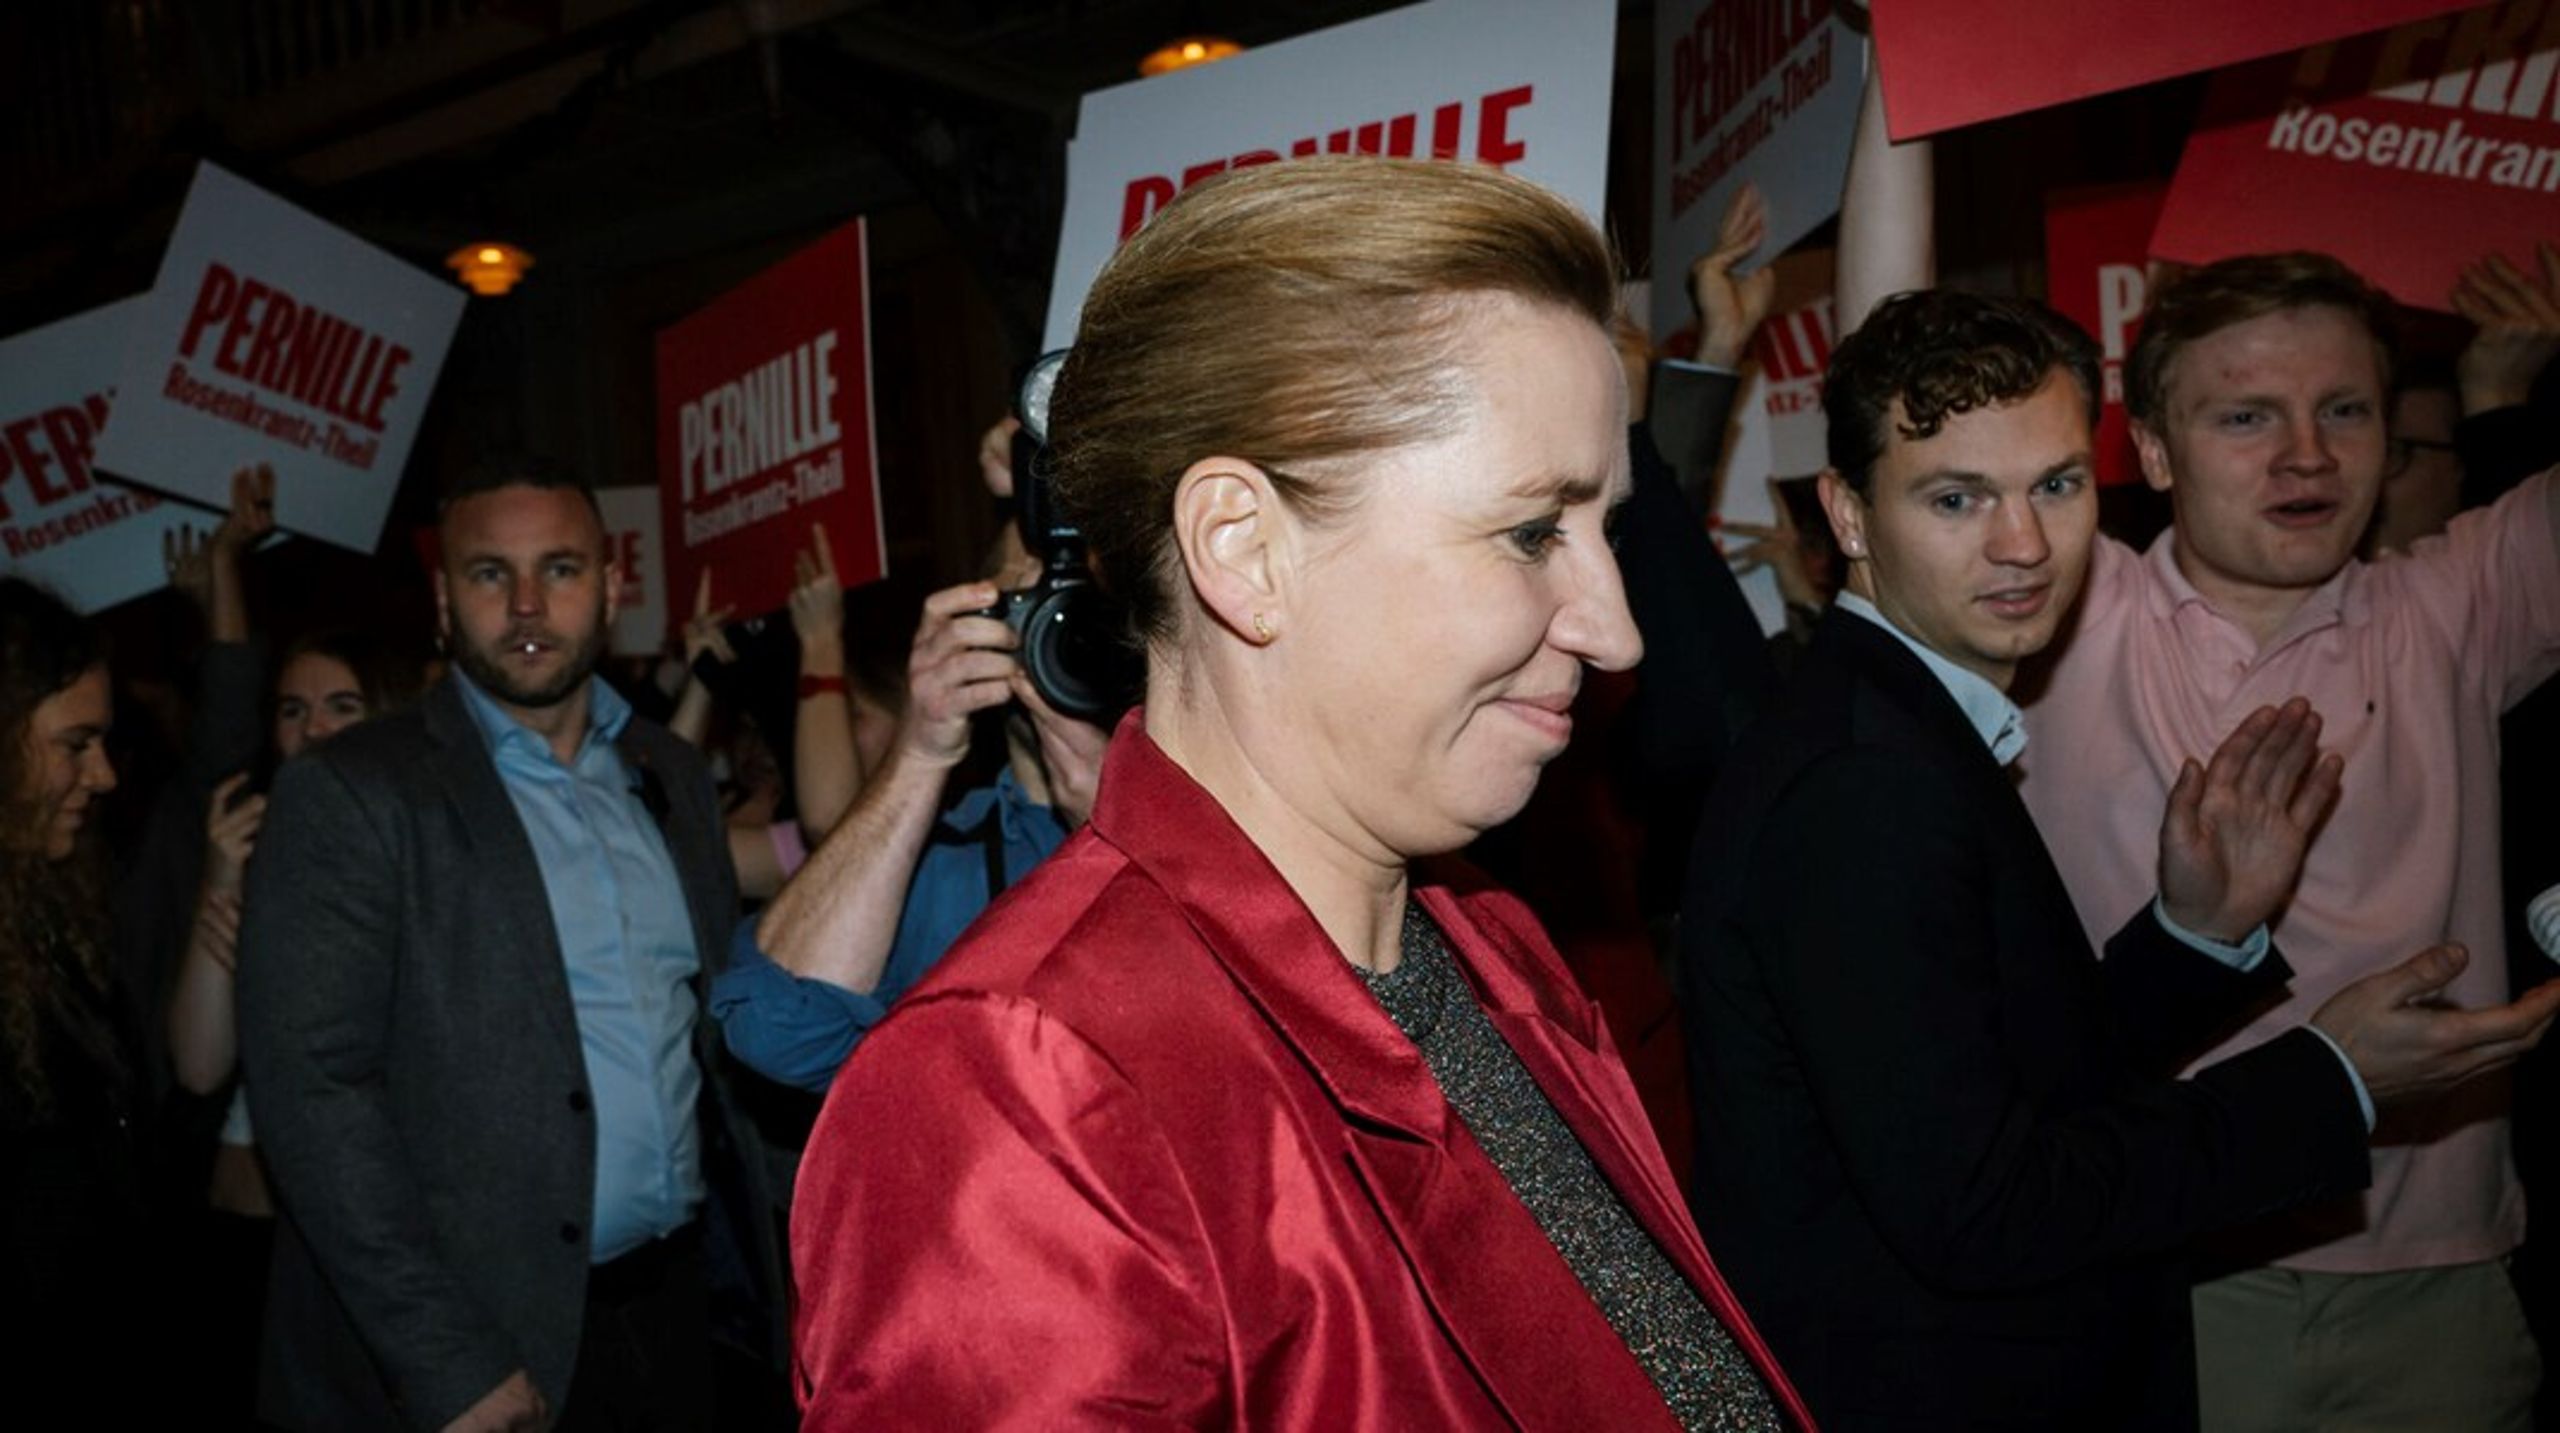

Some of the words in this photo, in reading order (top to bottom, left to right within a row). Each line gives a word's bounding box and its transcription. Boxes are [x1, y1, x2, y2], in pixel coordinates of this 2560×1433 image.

[164, 362, 380, 471] Rosenkrantz-Theil
[180, 263, 410, 432] PERNILLE
[680, 328, 843, 504] PERNILLE
